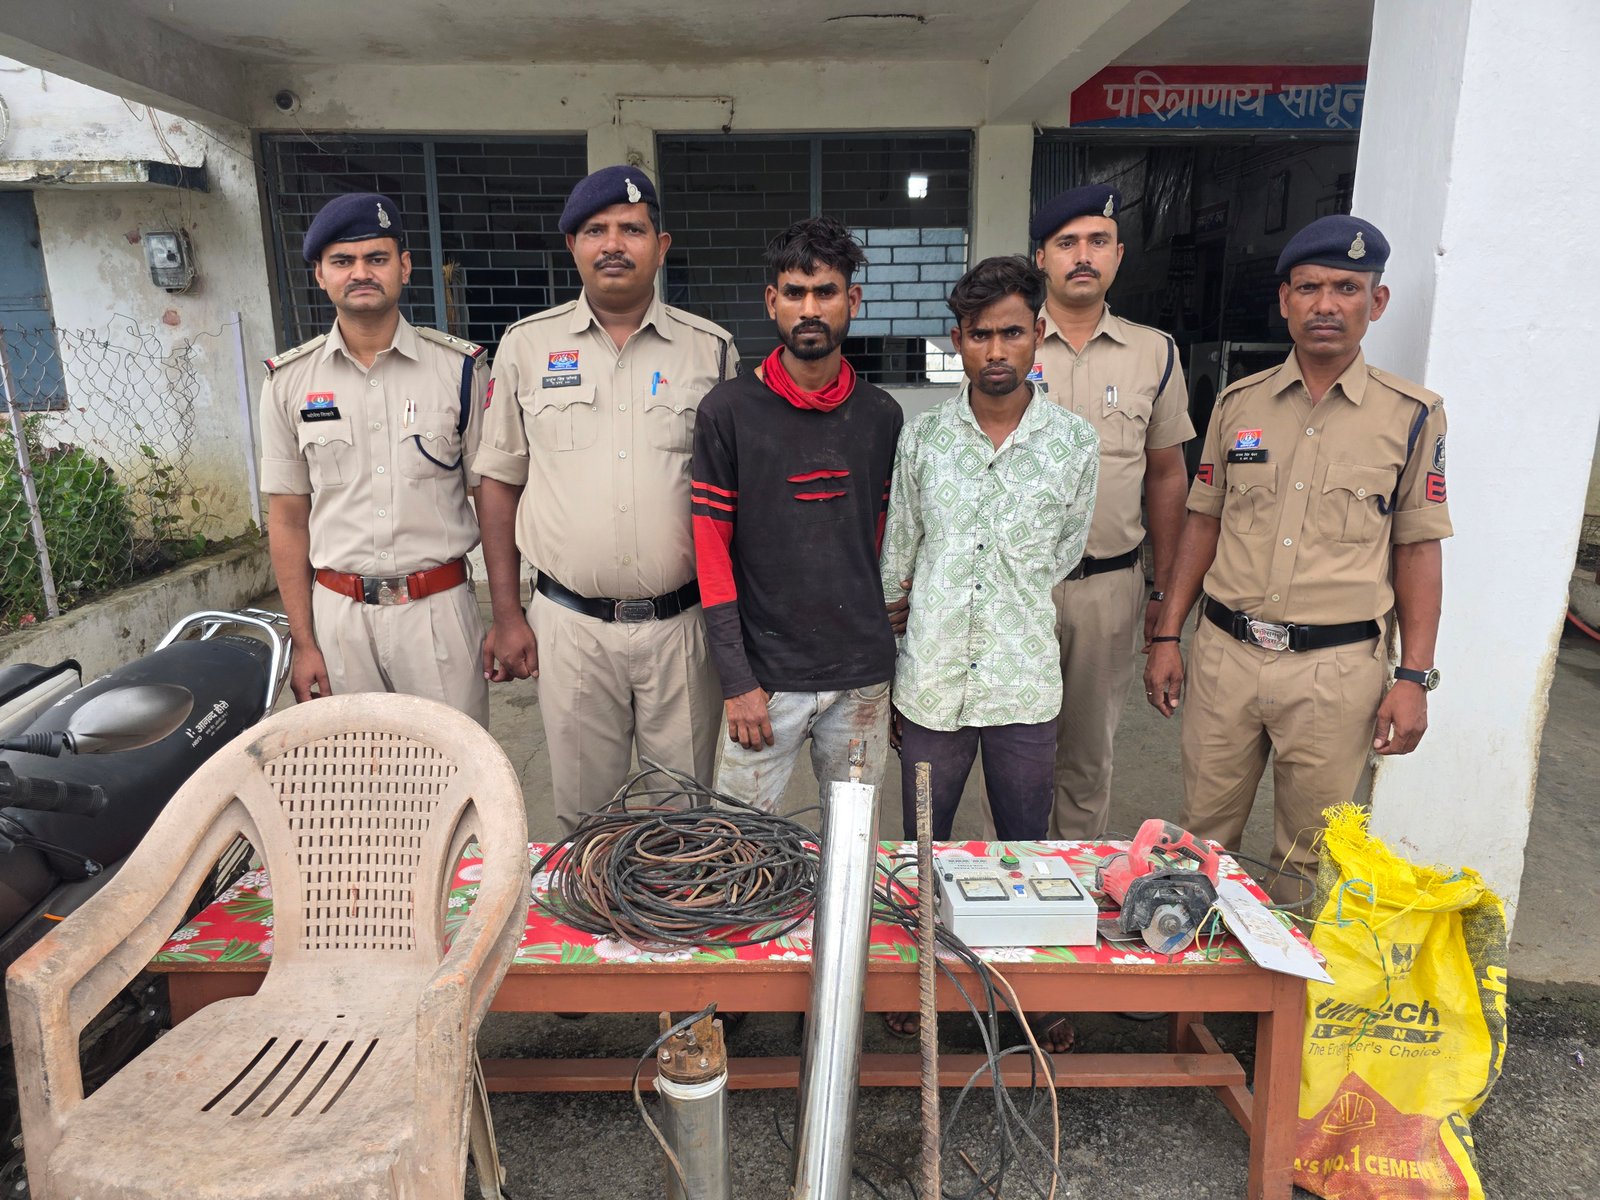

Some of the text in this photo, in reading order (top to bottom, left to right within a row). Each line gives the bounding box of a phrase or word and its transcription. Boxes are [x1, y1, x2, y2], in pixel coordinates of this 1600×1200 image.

[1103, 70, 1272, 122] परित्राणाय
[1309, 1041, 1441, 1058] The Enger's Choice
